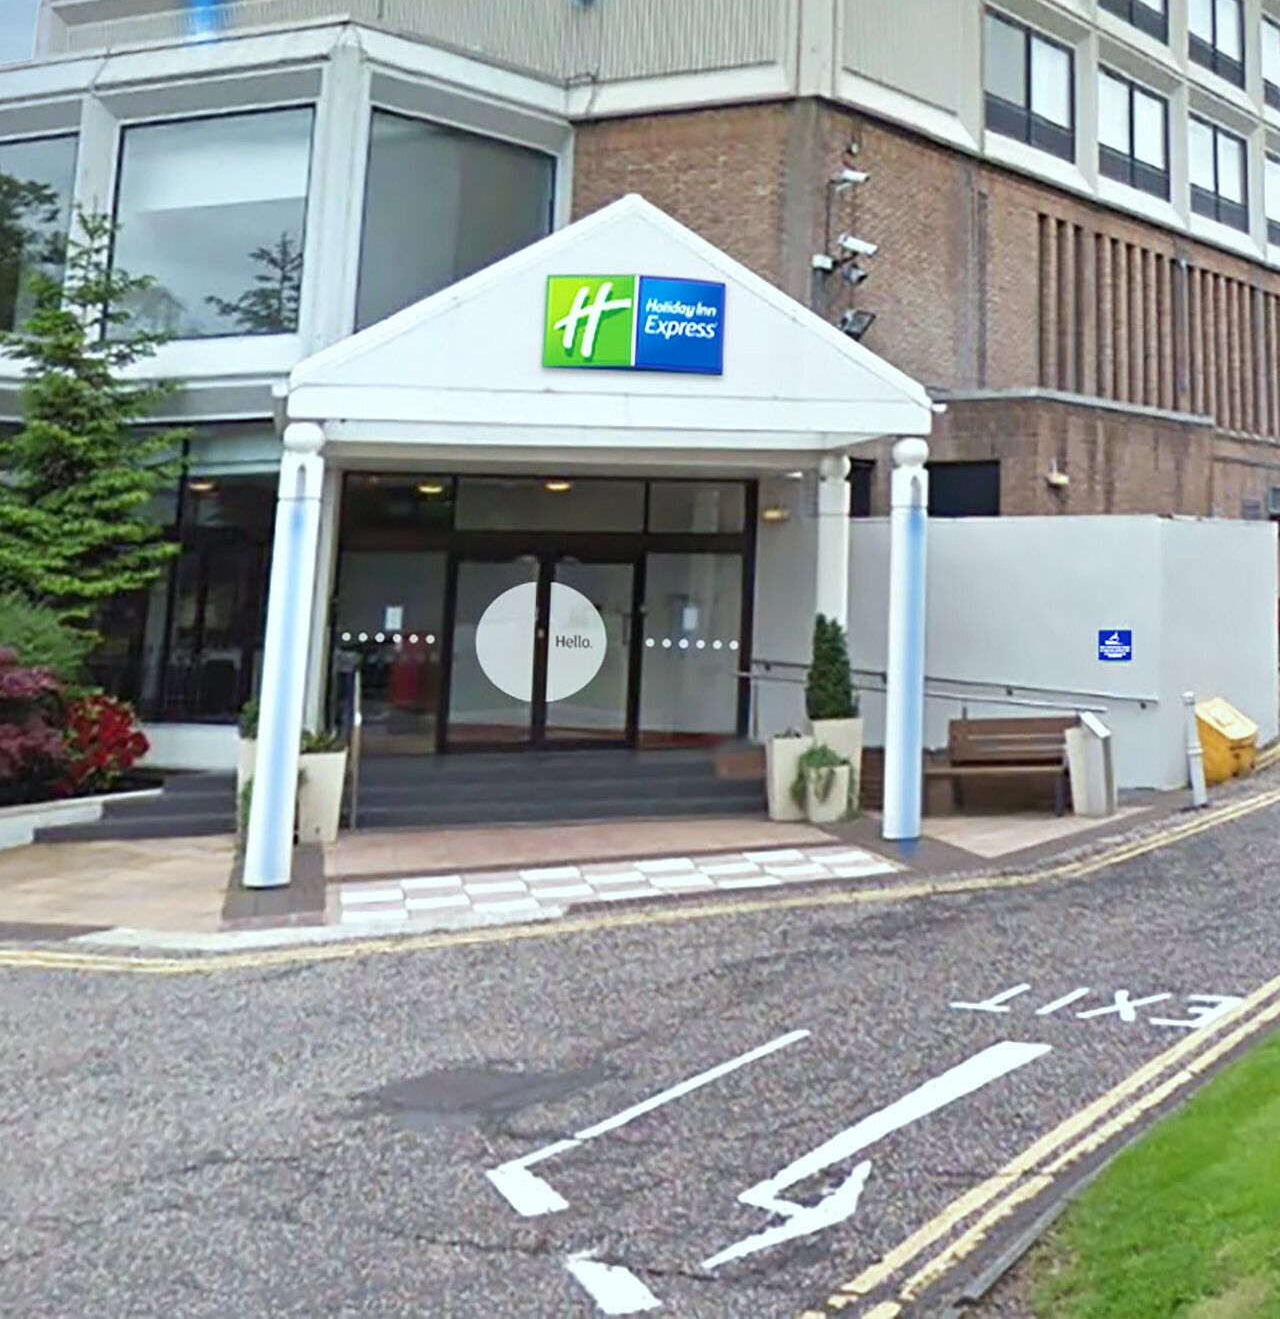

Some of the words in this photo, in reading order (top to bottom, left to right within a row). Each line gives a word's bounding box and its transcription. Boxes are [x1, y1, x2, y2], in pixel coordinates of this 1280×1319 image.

[645, 297, 696, 318] Holiday
[696, 301, 717, 317] Inn
[644, 314, 716, 340] Express
[555, 635, 593, 649] Hello.
[949, 982, 1244, 1029] EXIT
